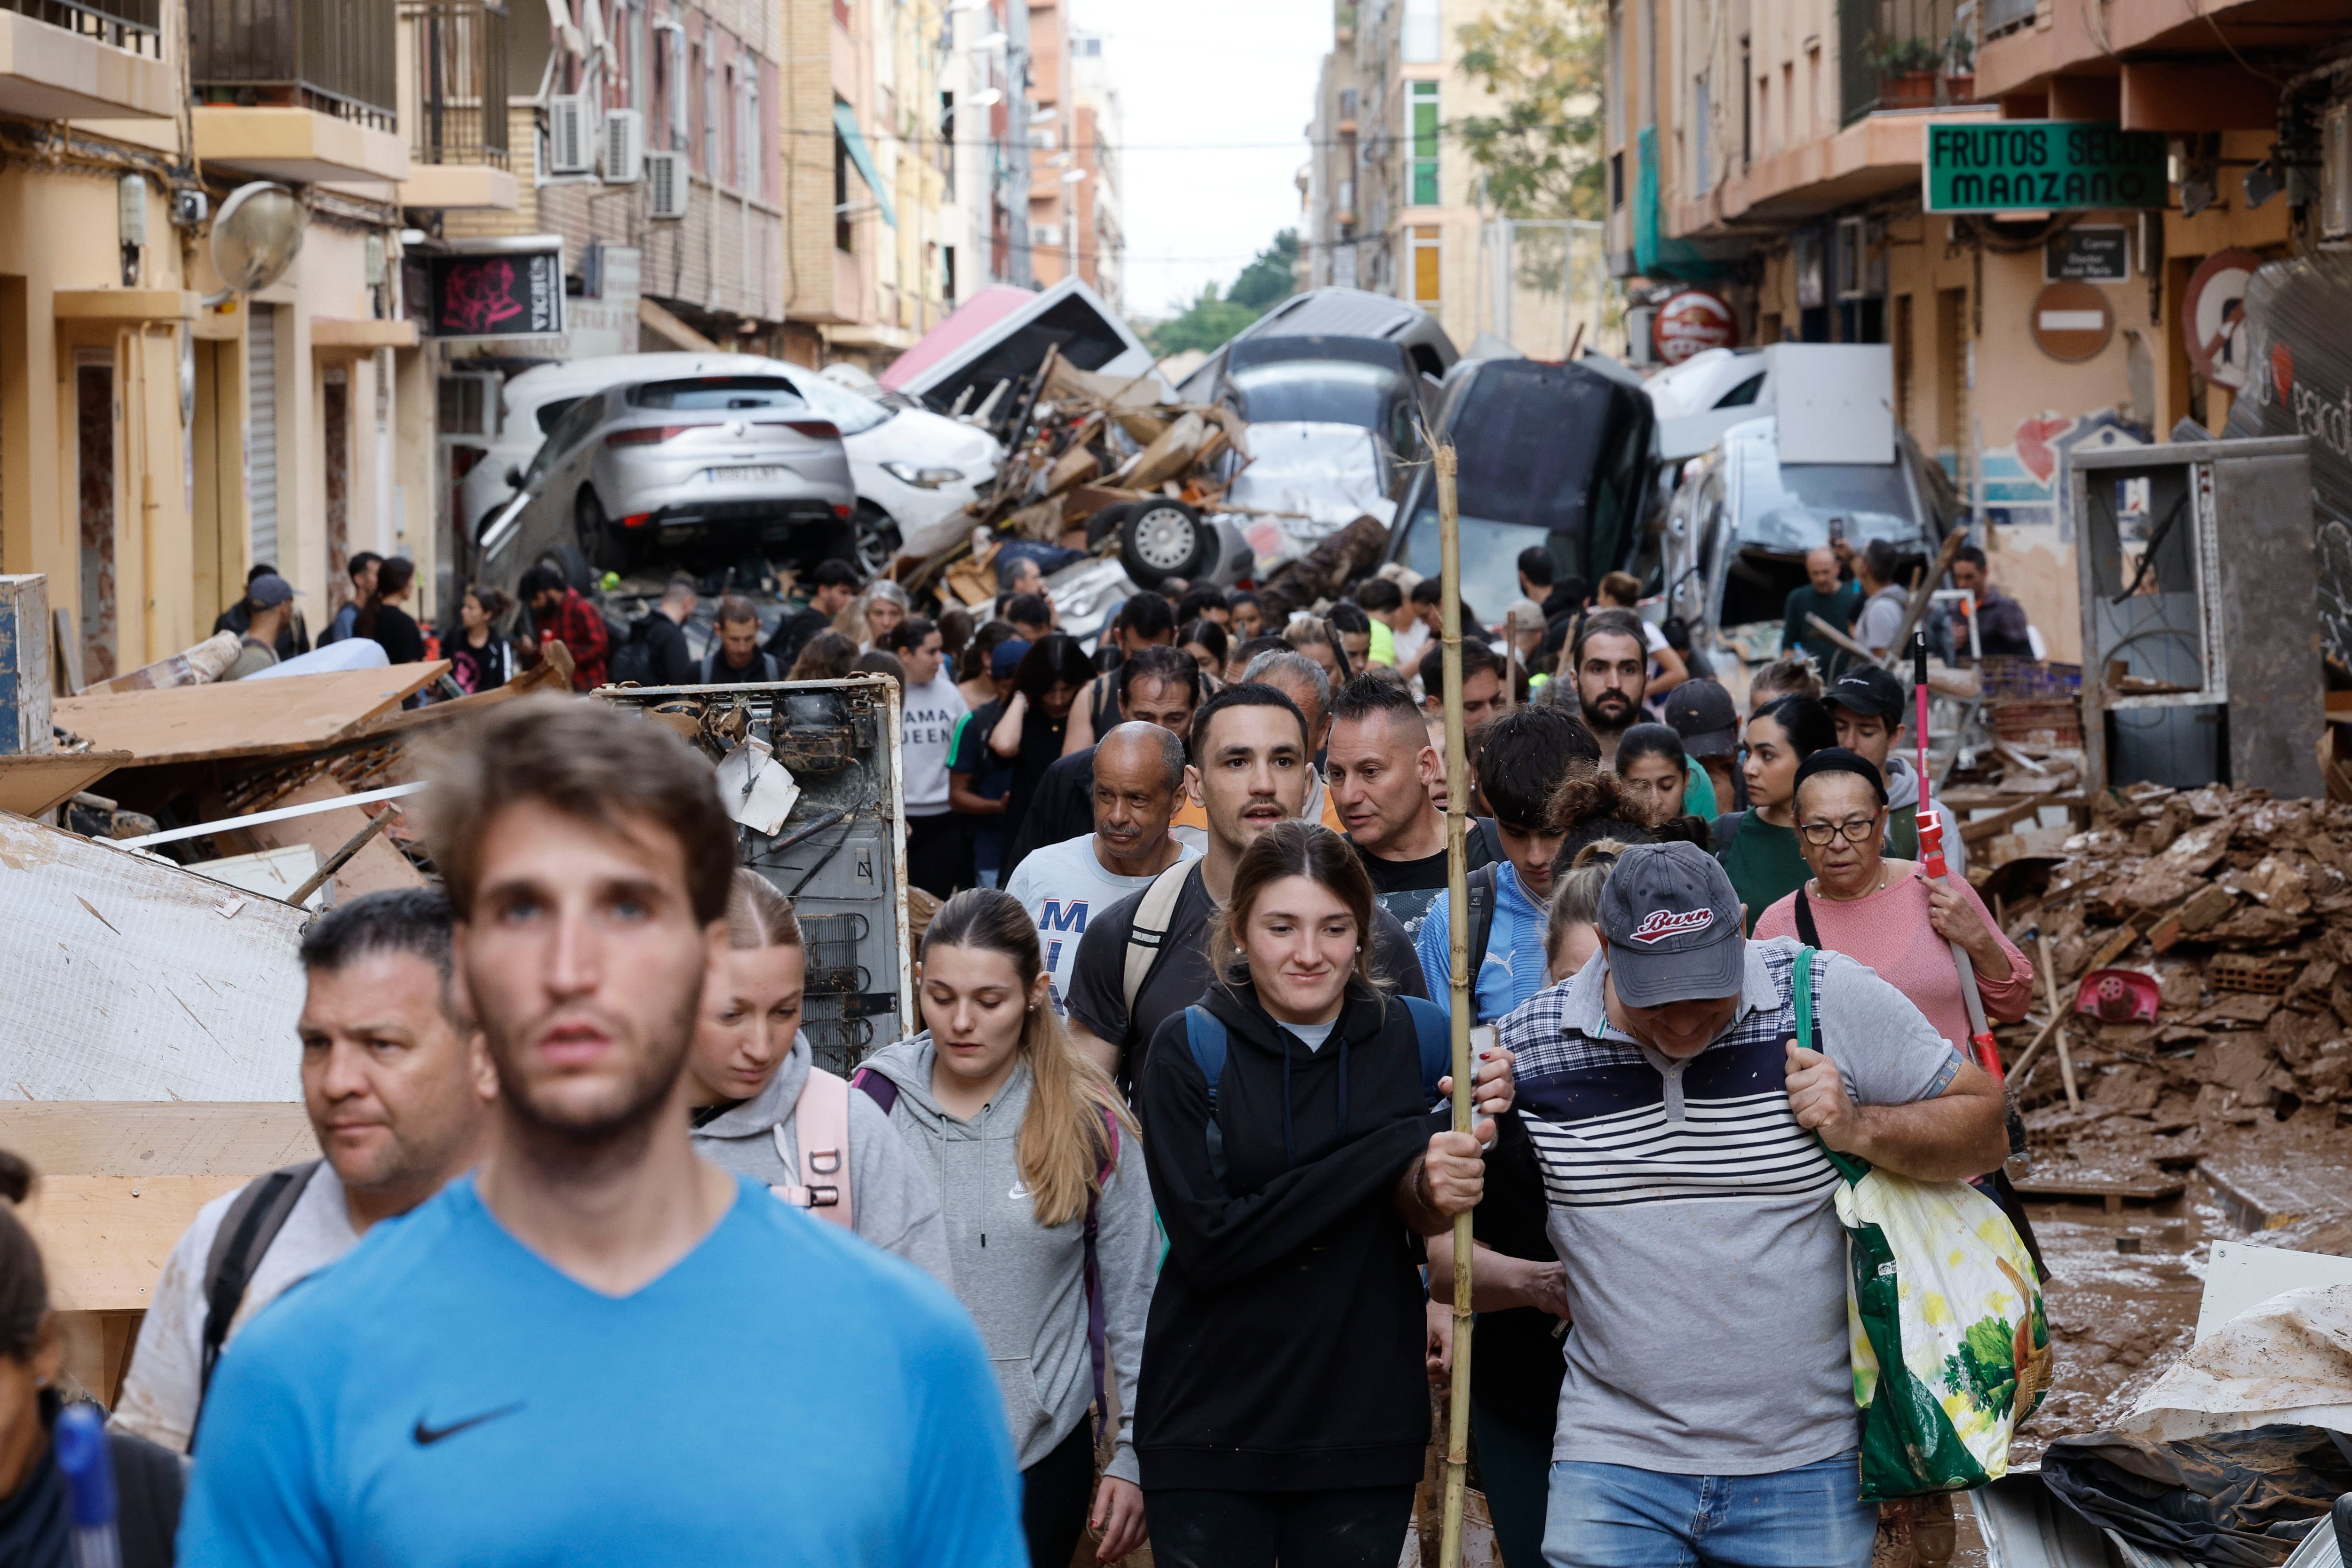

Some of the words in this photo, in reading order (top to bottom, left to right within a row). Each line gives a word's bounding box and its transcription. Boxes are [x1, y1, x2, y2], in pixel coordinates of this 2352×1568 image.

[1934, 130, 2048, 167] FRUTOS
[2067, 130, 2163, 166] SECOS
[906, 709, 950, 724] AMA
[902, 728, 951, 744] UEEN
